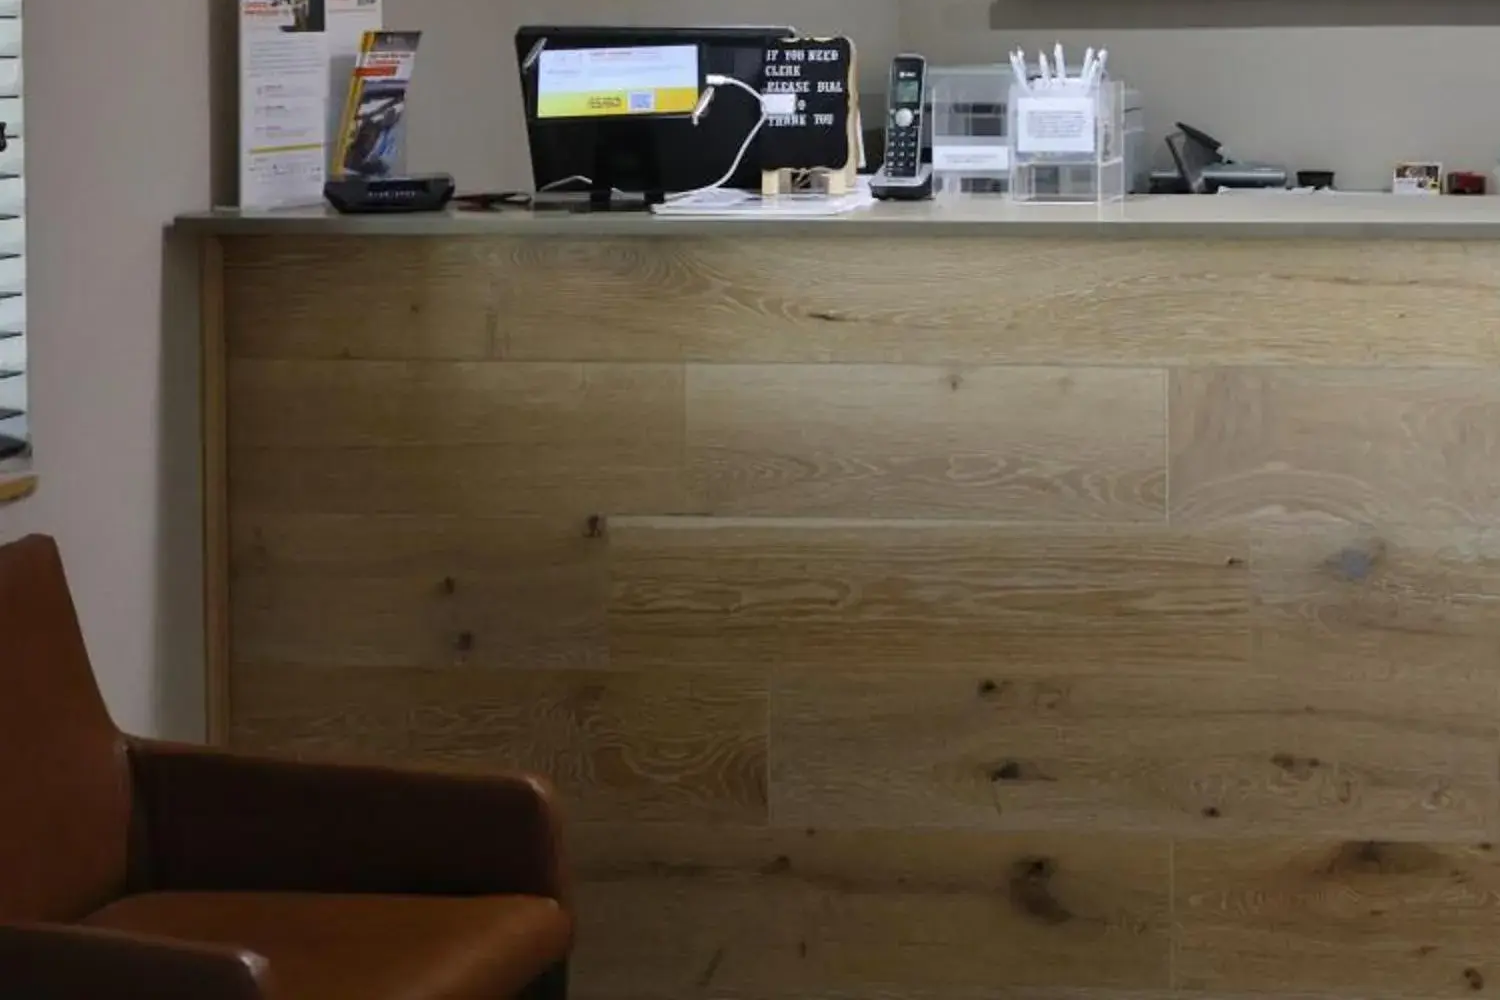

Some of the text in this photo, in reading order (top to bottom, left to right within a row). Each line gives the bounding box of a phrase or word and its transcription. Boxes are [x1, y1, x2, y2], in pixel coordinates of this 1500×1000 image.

[766, 49, 839, 62] IF YOU NEED
[764, 65, 802, 77] CLERK
[766, 81, 843, 93] PLEASE DIAL
[767, 113, 834, 127] THANK YOU
